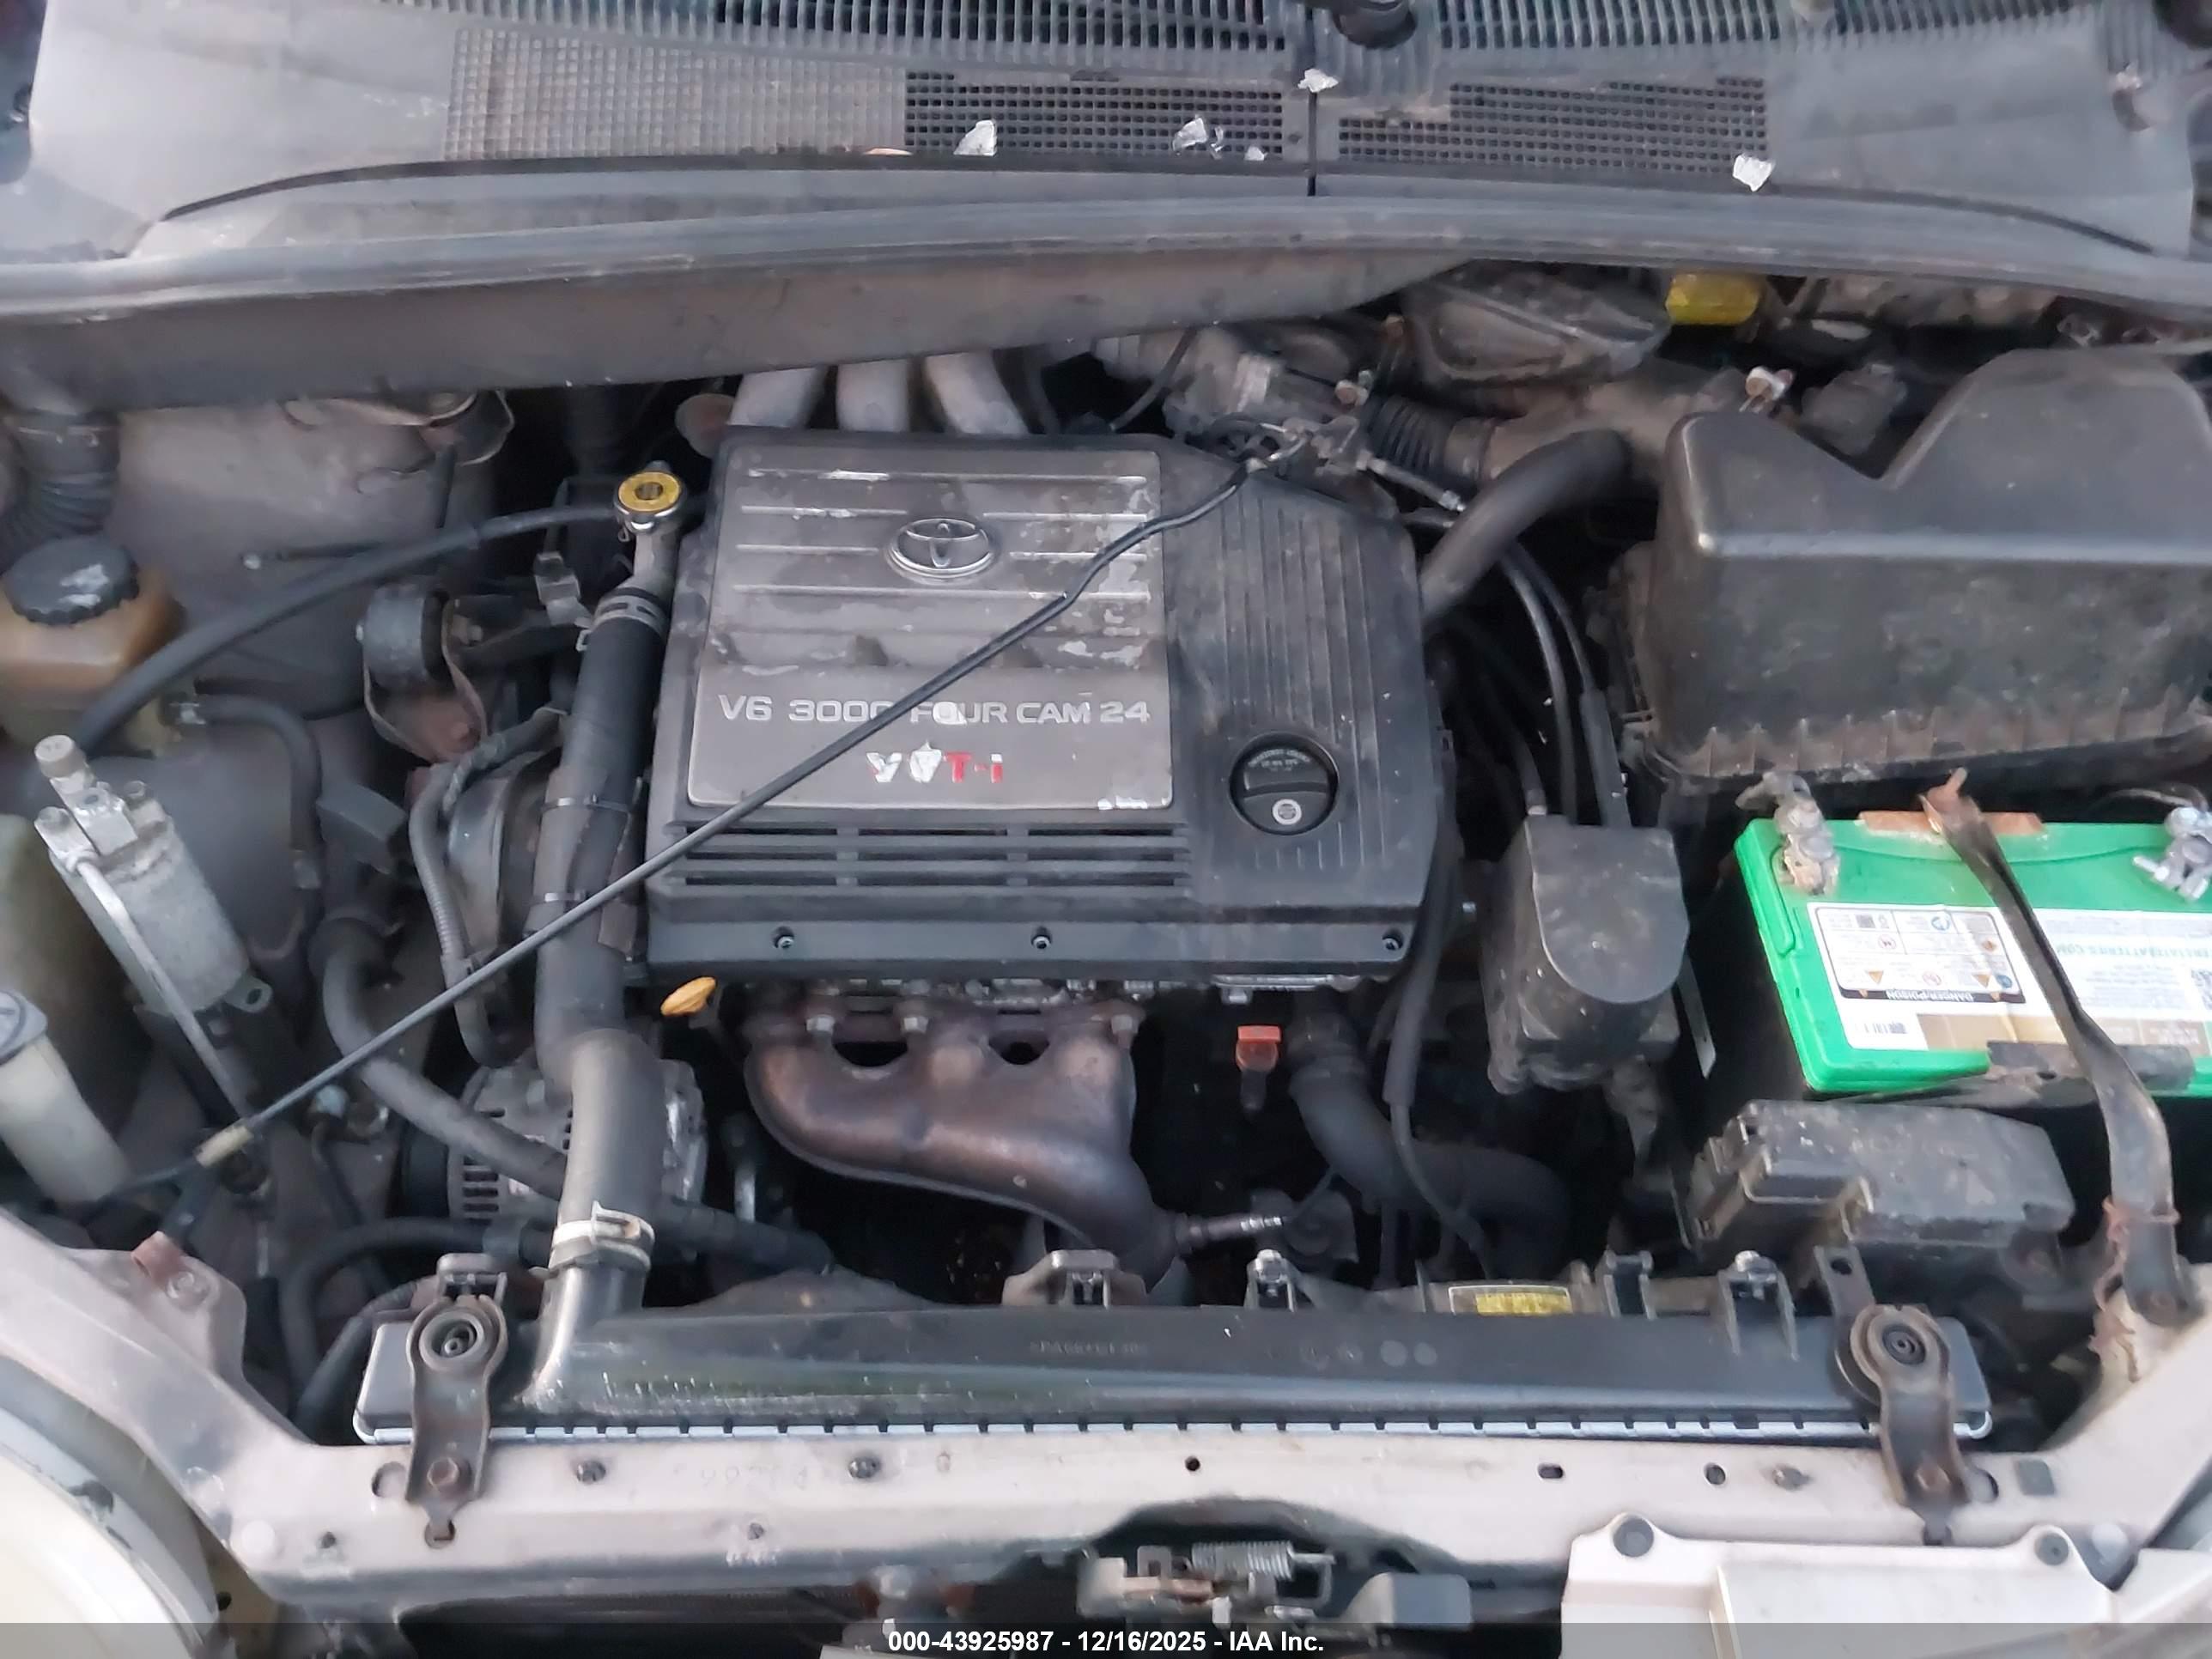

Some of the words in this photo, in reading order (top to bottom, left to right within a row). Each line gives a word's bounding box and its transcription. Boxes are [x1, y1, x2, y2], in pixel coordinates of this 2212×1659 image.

[718, 694, 772, 721] V6
[910, 700, 1009, 725] FOUR
[1016, 701, 1092, 723] CAM
[1099, 700, 1151, 723] 24
